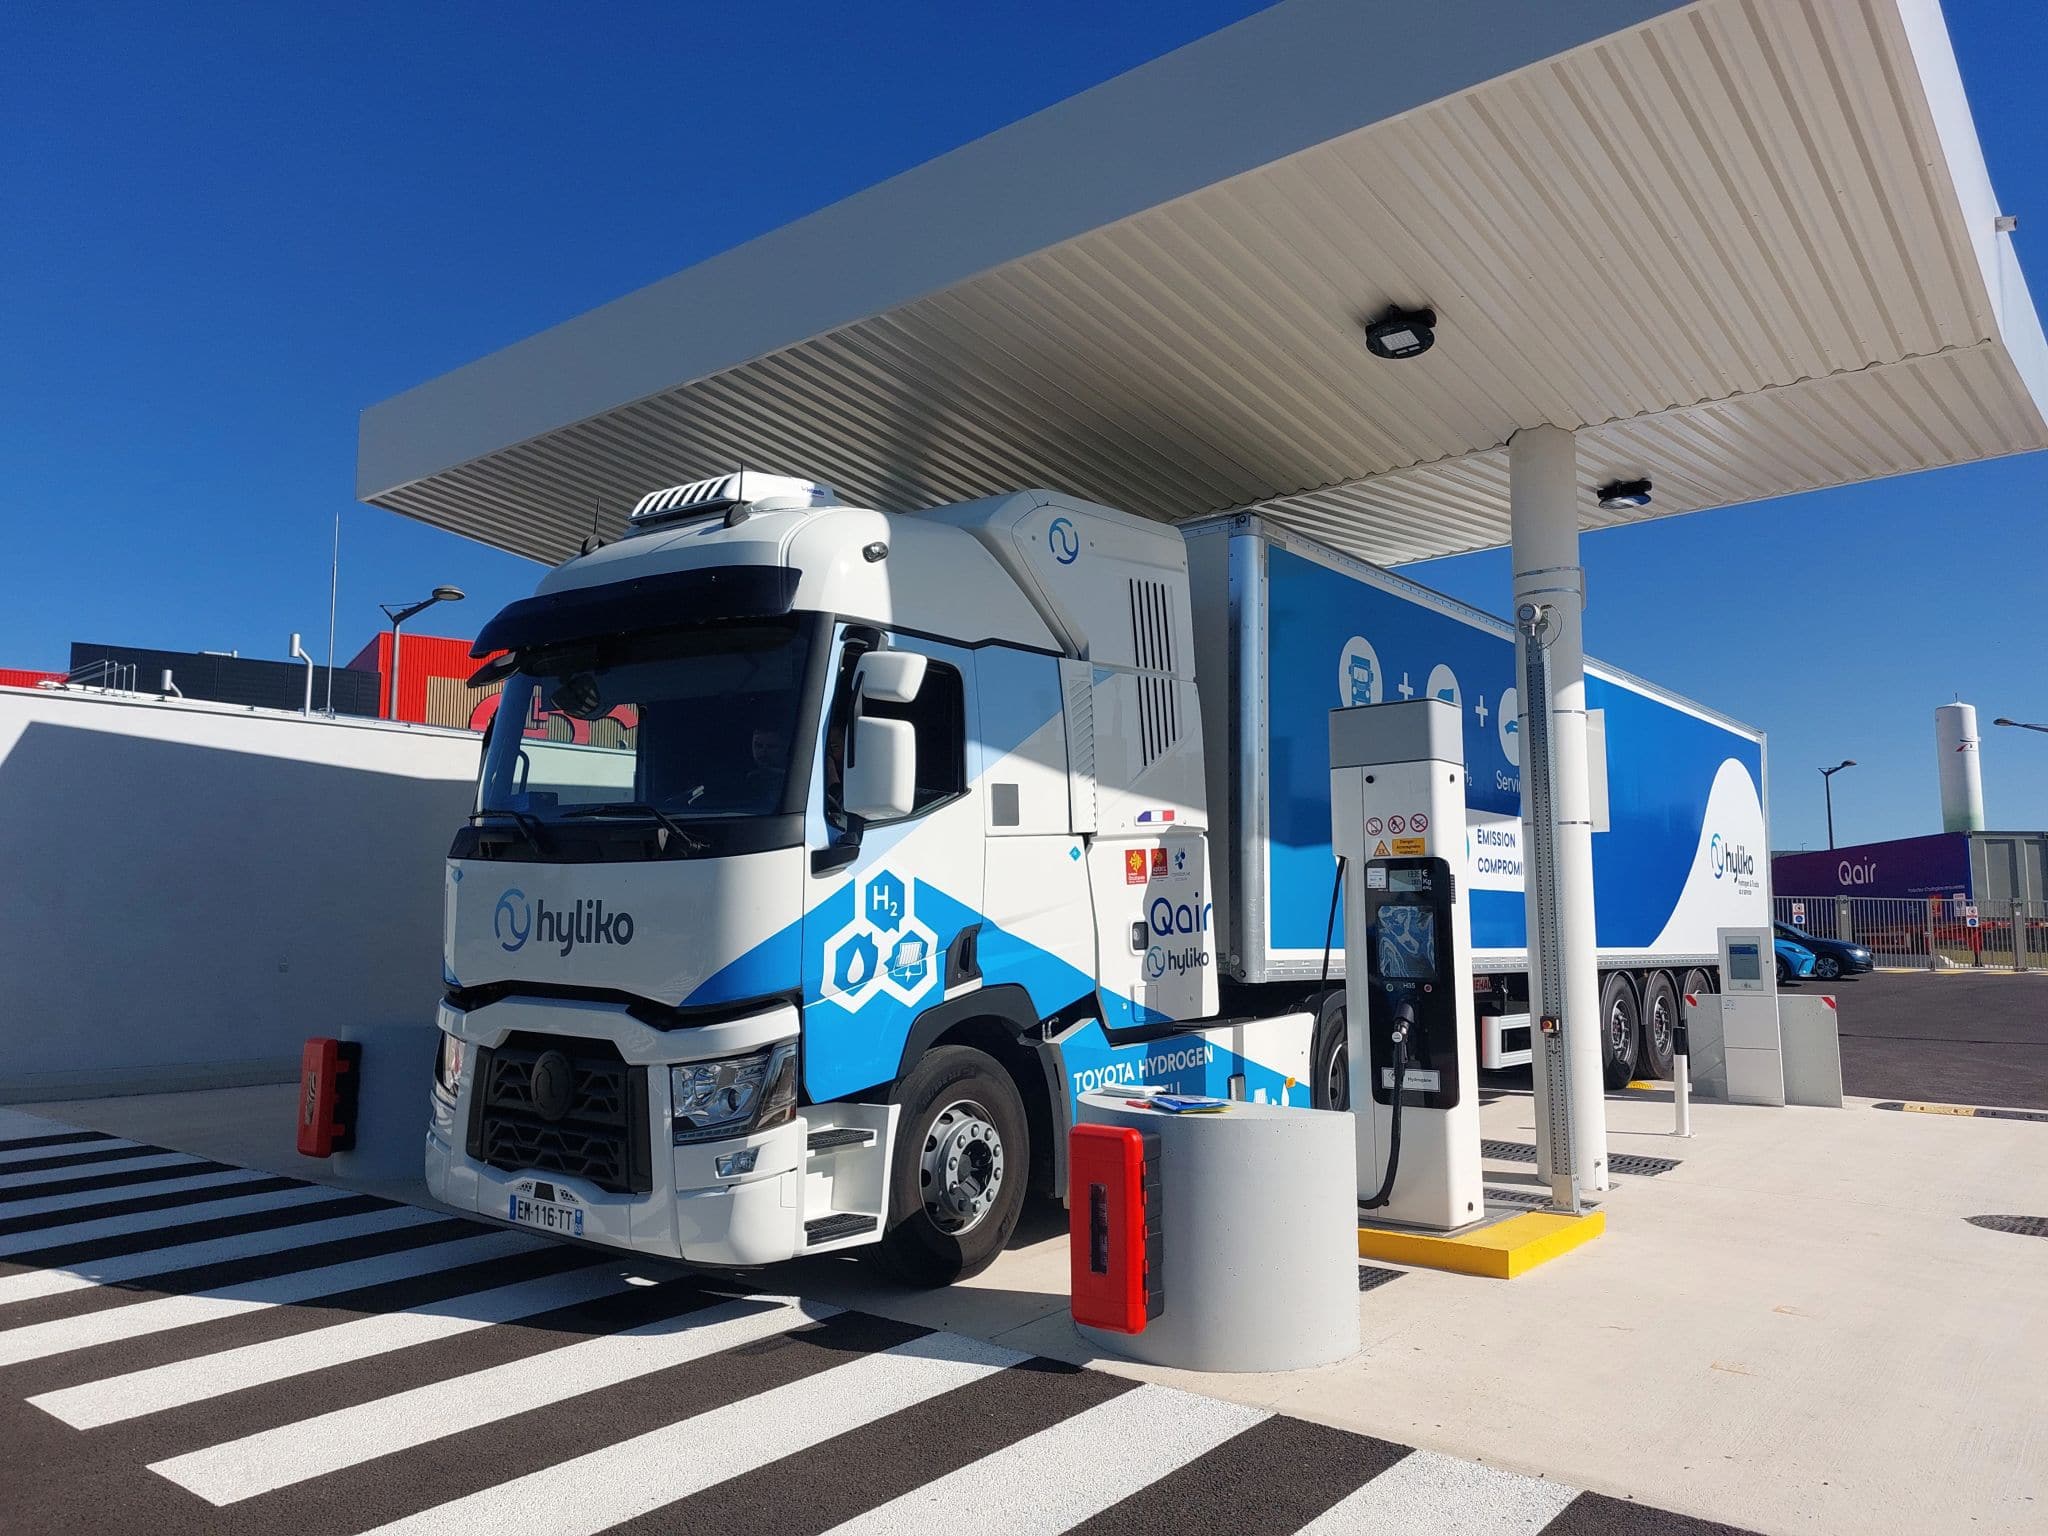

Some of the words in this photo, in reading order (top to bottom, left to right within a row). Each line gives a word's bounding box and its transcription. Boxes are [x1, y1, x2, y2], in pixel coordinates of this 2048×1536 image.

[1477, 824, 1516, 848] ÉMISSION
[1725, 842, 1754, 883] hyliko
[1838, 855, 1877, 886] Qair
[536, 898, 635, 958] hyliko
[1150, 891, 1212, 937] Qair
[1167, 946, 1210, 977] hyliko
[1073, 1063, 1135, 1093] TOYOTA
[1138, 1045, 1214, 1081] HYDROGEN
